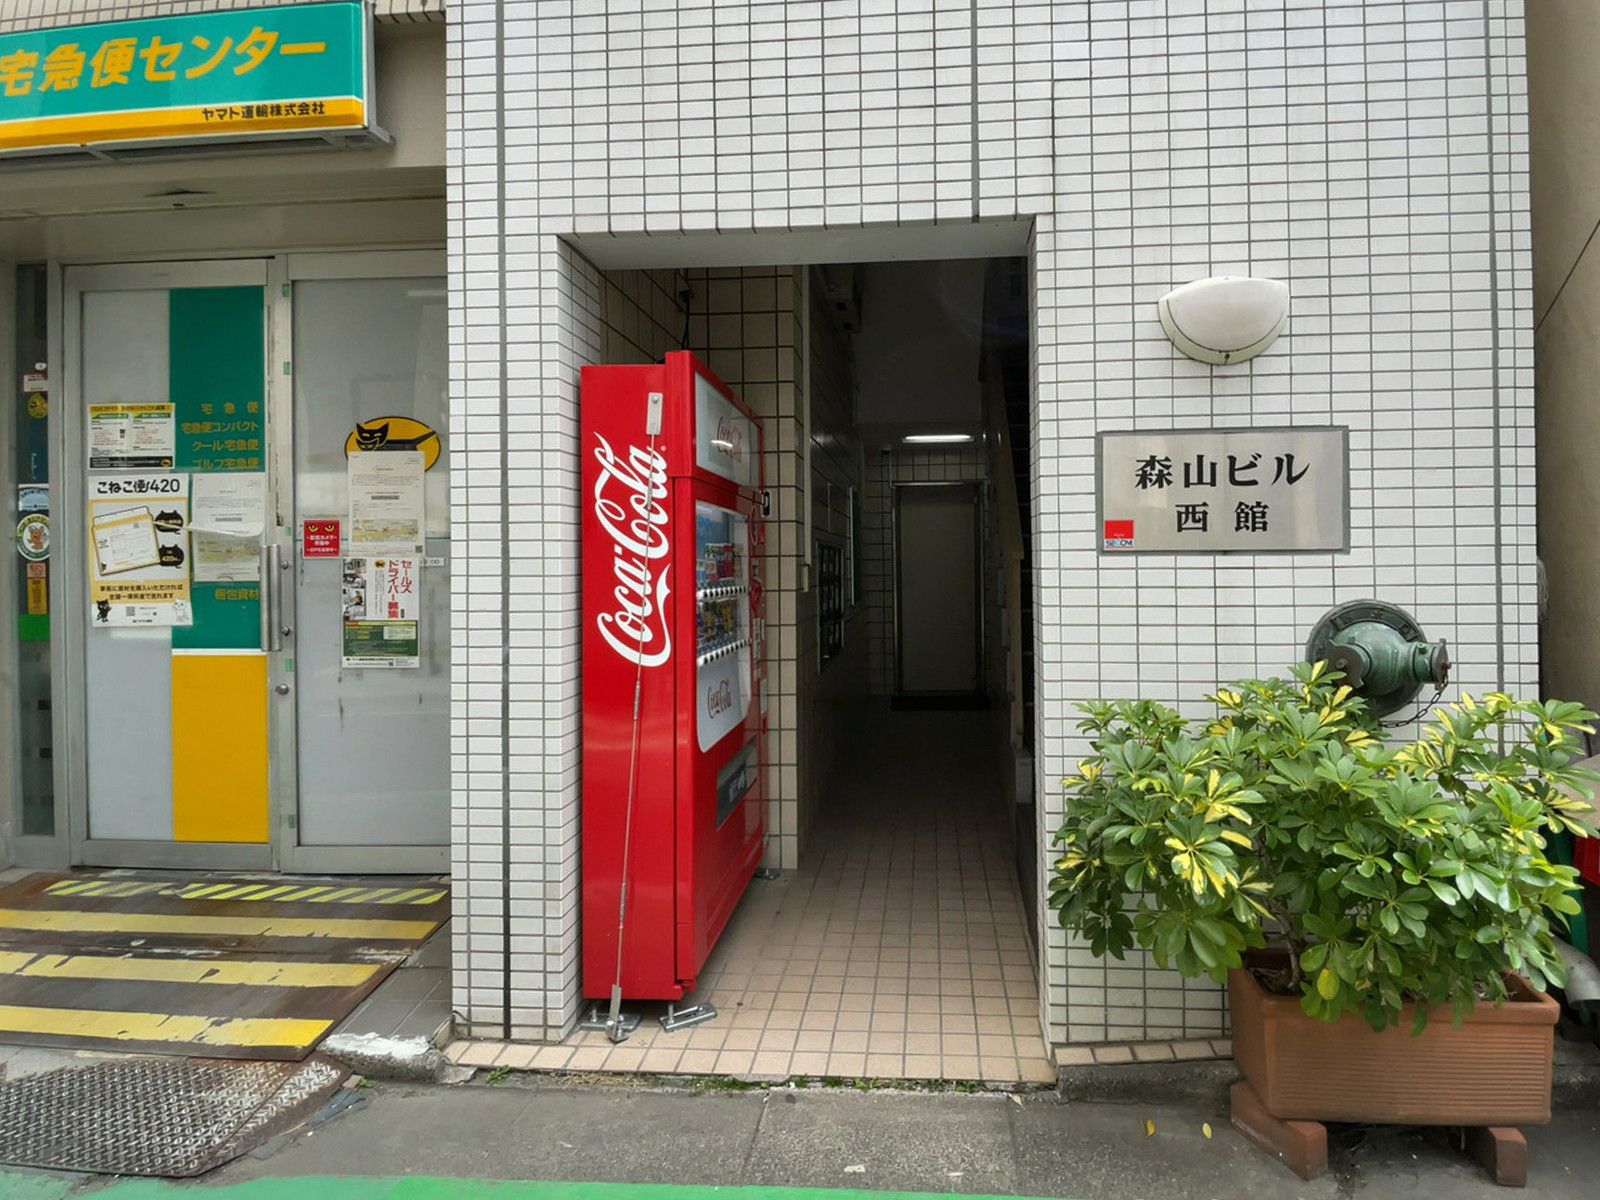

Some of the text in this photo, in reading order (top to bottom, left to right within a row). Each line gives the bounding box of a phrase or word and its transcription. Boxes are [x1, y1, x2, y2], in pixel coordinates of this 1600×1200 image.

[0, 26, 326, 96] 宅急便センター
[202, 101, 325, 121] ヤマト運輸株式会社
[1135, 453, 1310, 490] 森山ビル
[1175, 502, 1269, 532] 西館
[593, 432, 671, 667] Coca-Cola
[707, 680, 732, 720] Coca-Cola
